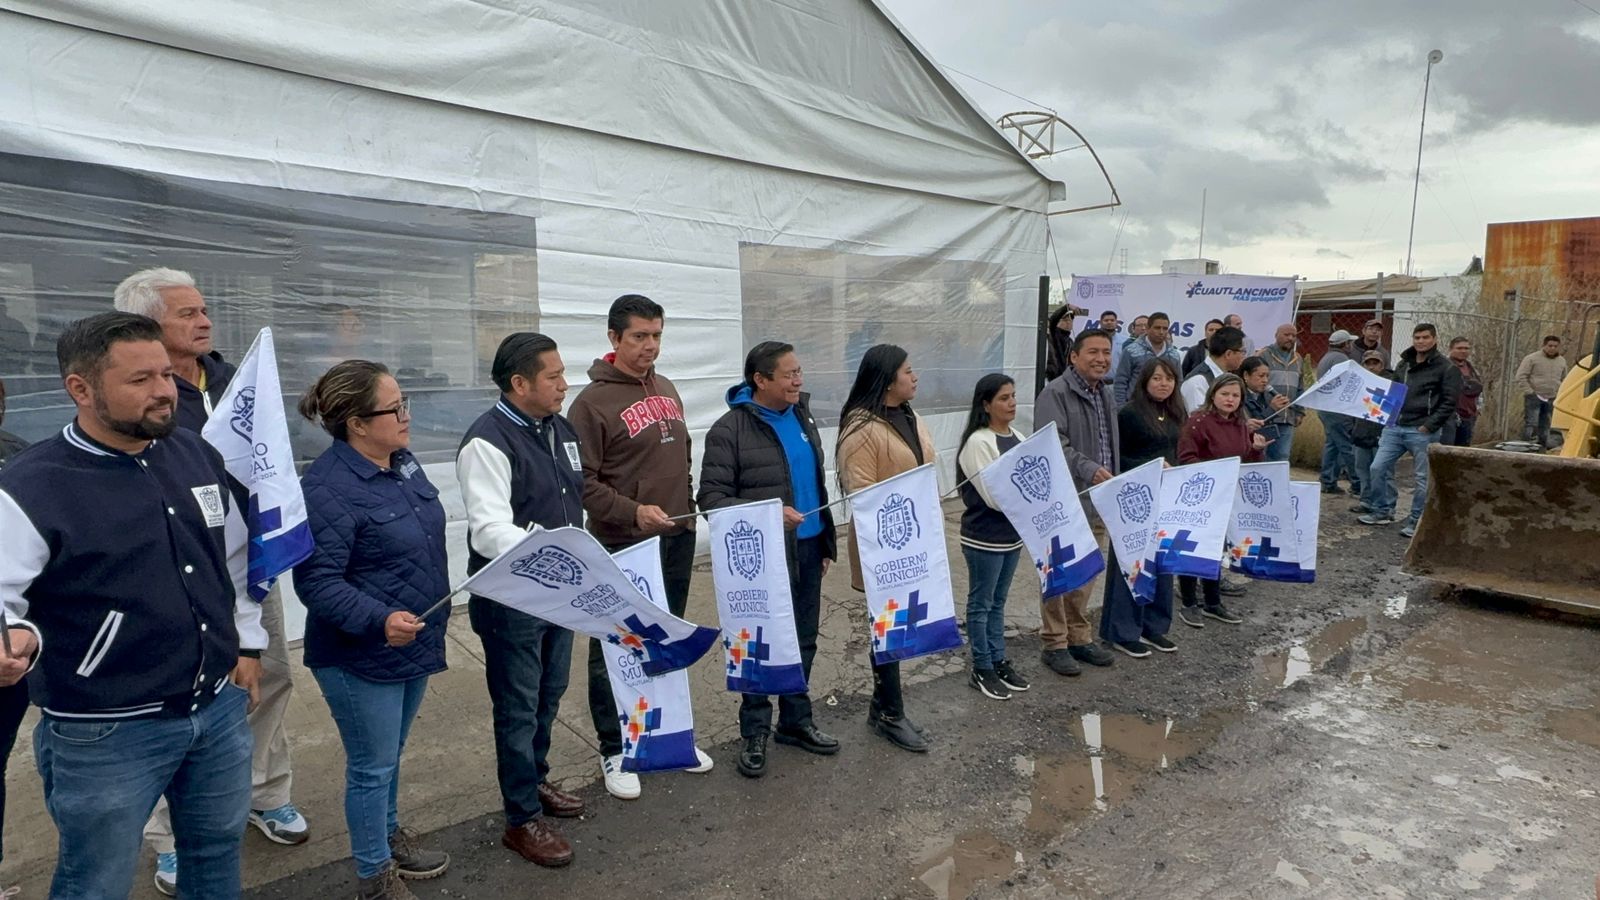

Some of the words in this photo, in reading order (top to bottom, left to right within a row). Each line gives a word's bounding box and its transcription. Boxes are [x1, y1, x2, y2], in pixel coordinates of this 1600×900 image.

[1194, 287, 1288, 297] CUAUTLANCINGO
[1085, 319, 1124, 333] MS
[1238, 512, 1279, 523] GOBIERNO
[1238, 520, 1281, 529] MUNICIPAL
[874, 551, 928, 575] GOBIERNO
[876, 563, 929, 586] MUNICIPAL
